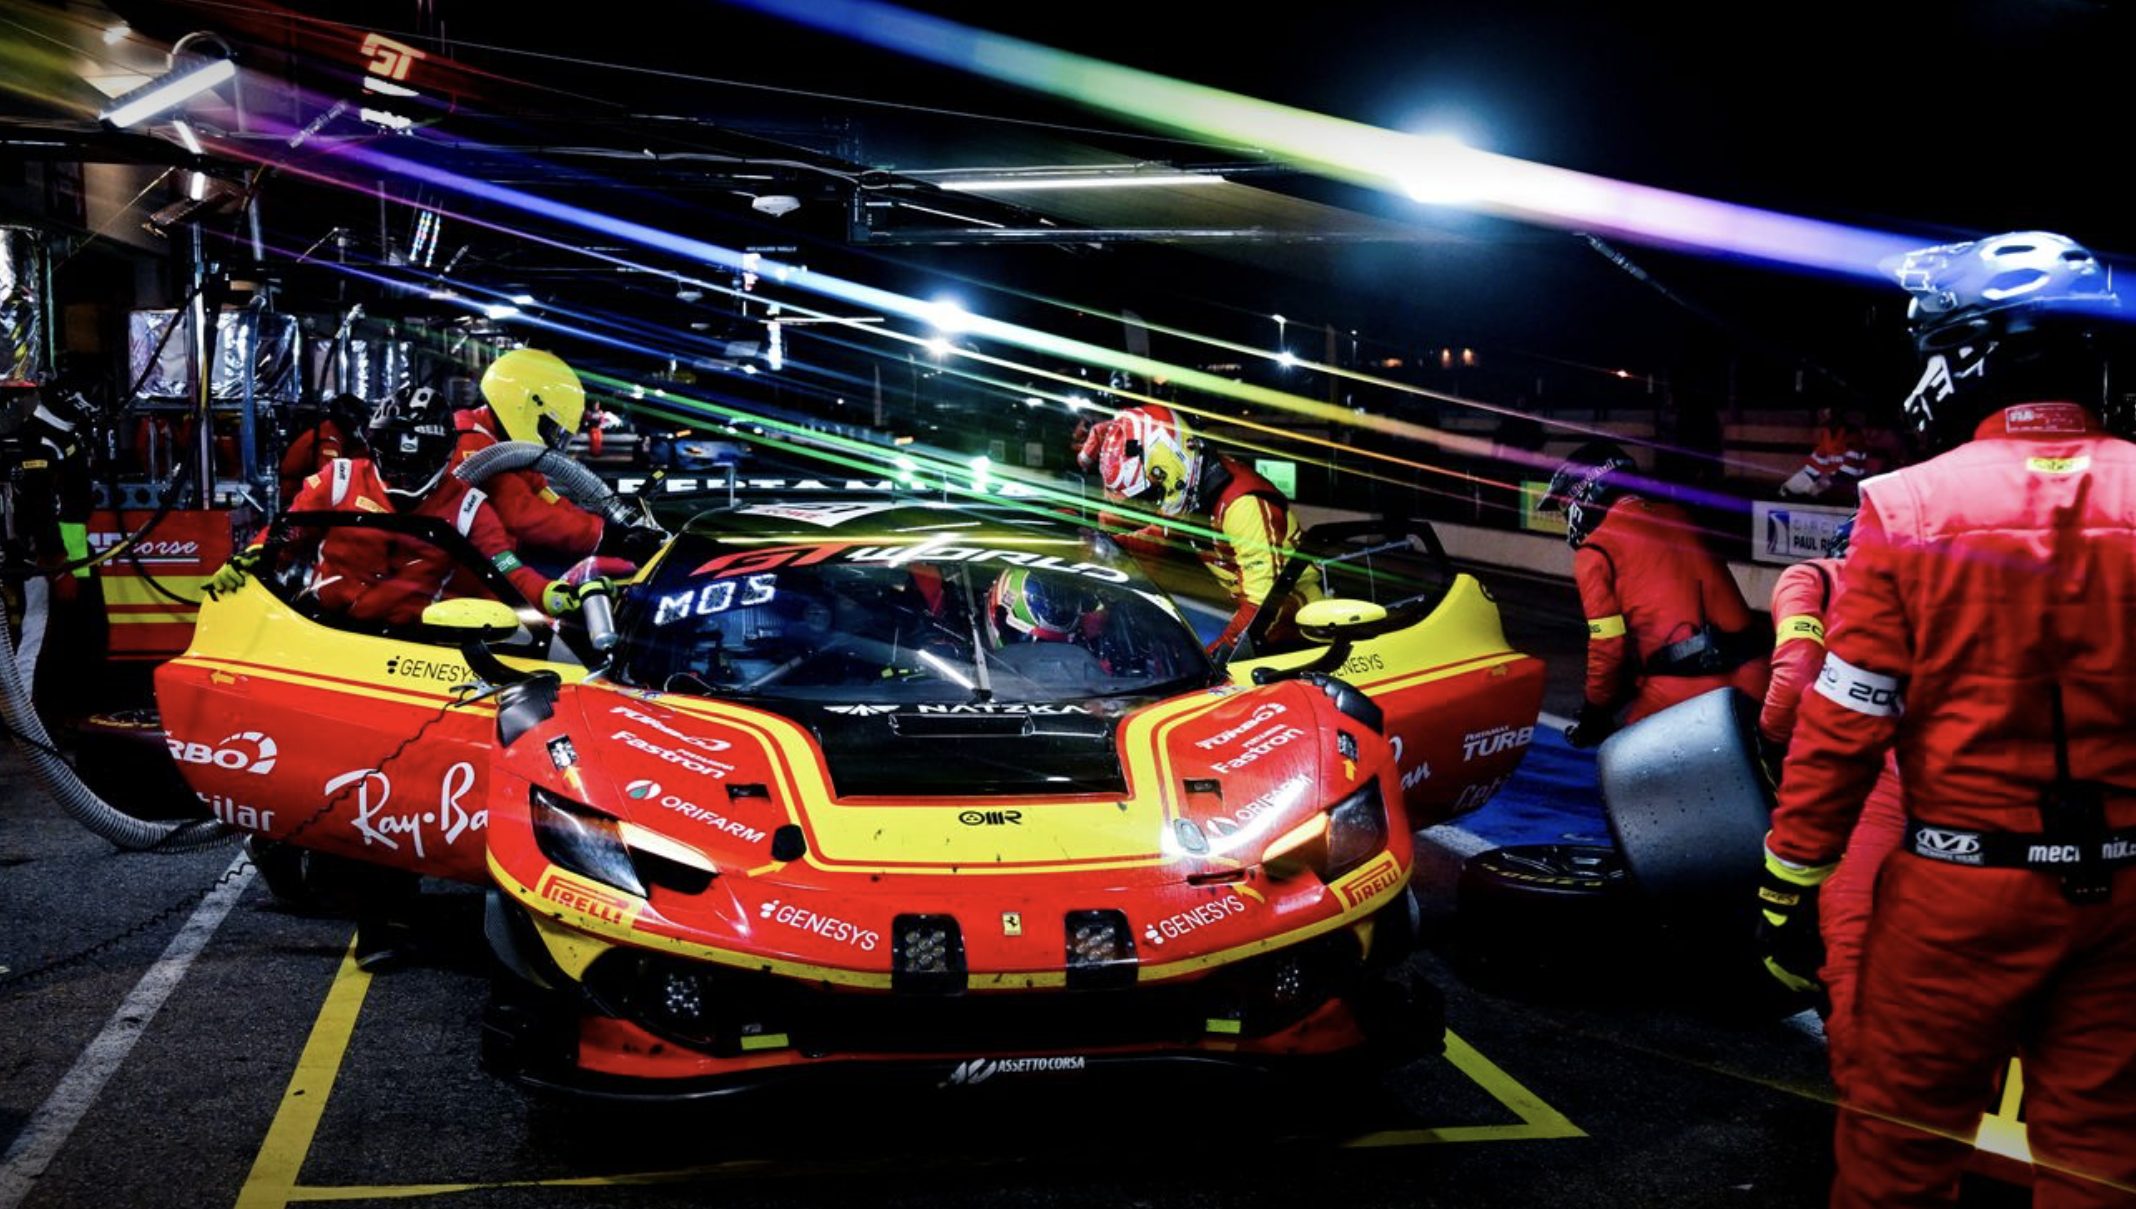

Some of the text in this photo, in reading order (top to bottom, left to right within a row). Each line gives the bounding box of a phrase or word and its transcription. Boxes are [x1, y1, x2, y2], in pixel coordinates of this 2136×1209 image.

[1793, 535, 1817, 551] PAUL
[610, 730, 726, 779] Fastron
[1210, 728, 1305, 774] Fastron
[660, 795, 766, 844] ORIFARM
[541, 874, 629, 925] PIRELLI
[1340, 860, 1398, 908] PIRELLI
[776, 905, 880, 951] GENESYS
[1159, 895, 1245, 938] GENESYS
[997, 1056, 1086, 1073] ASSETTO CORSA
